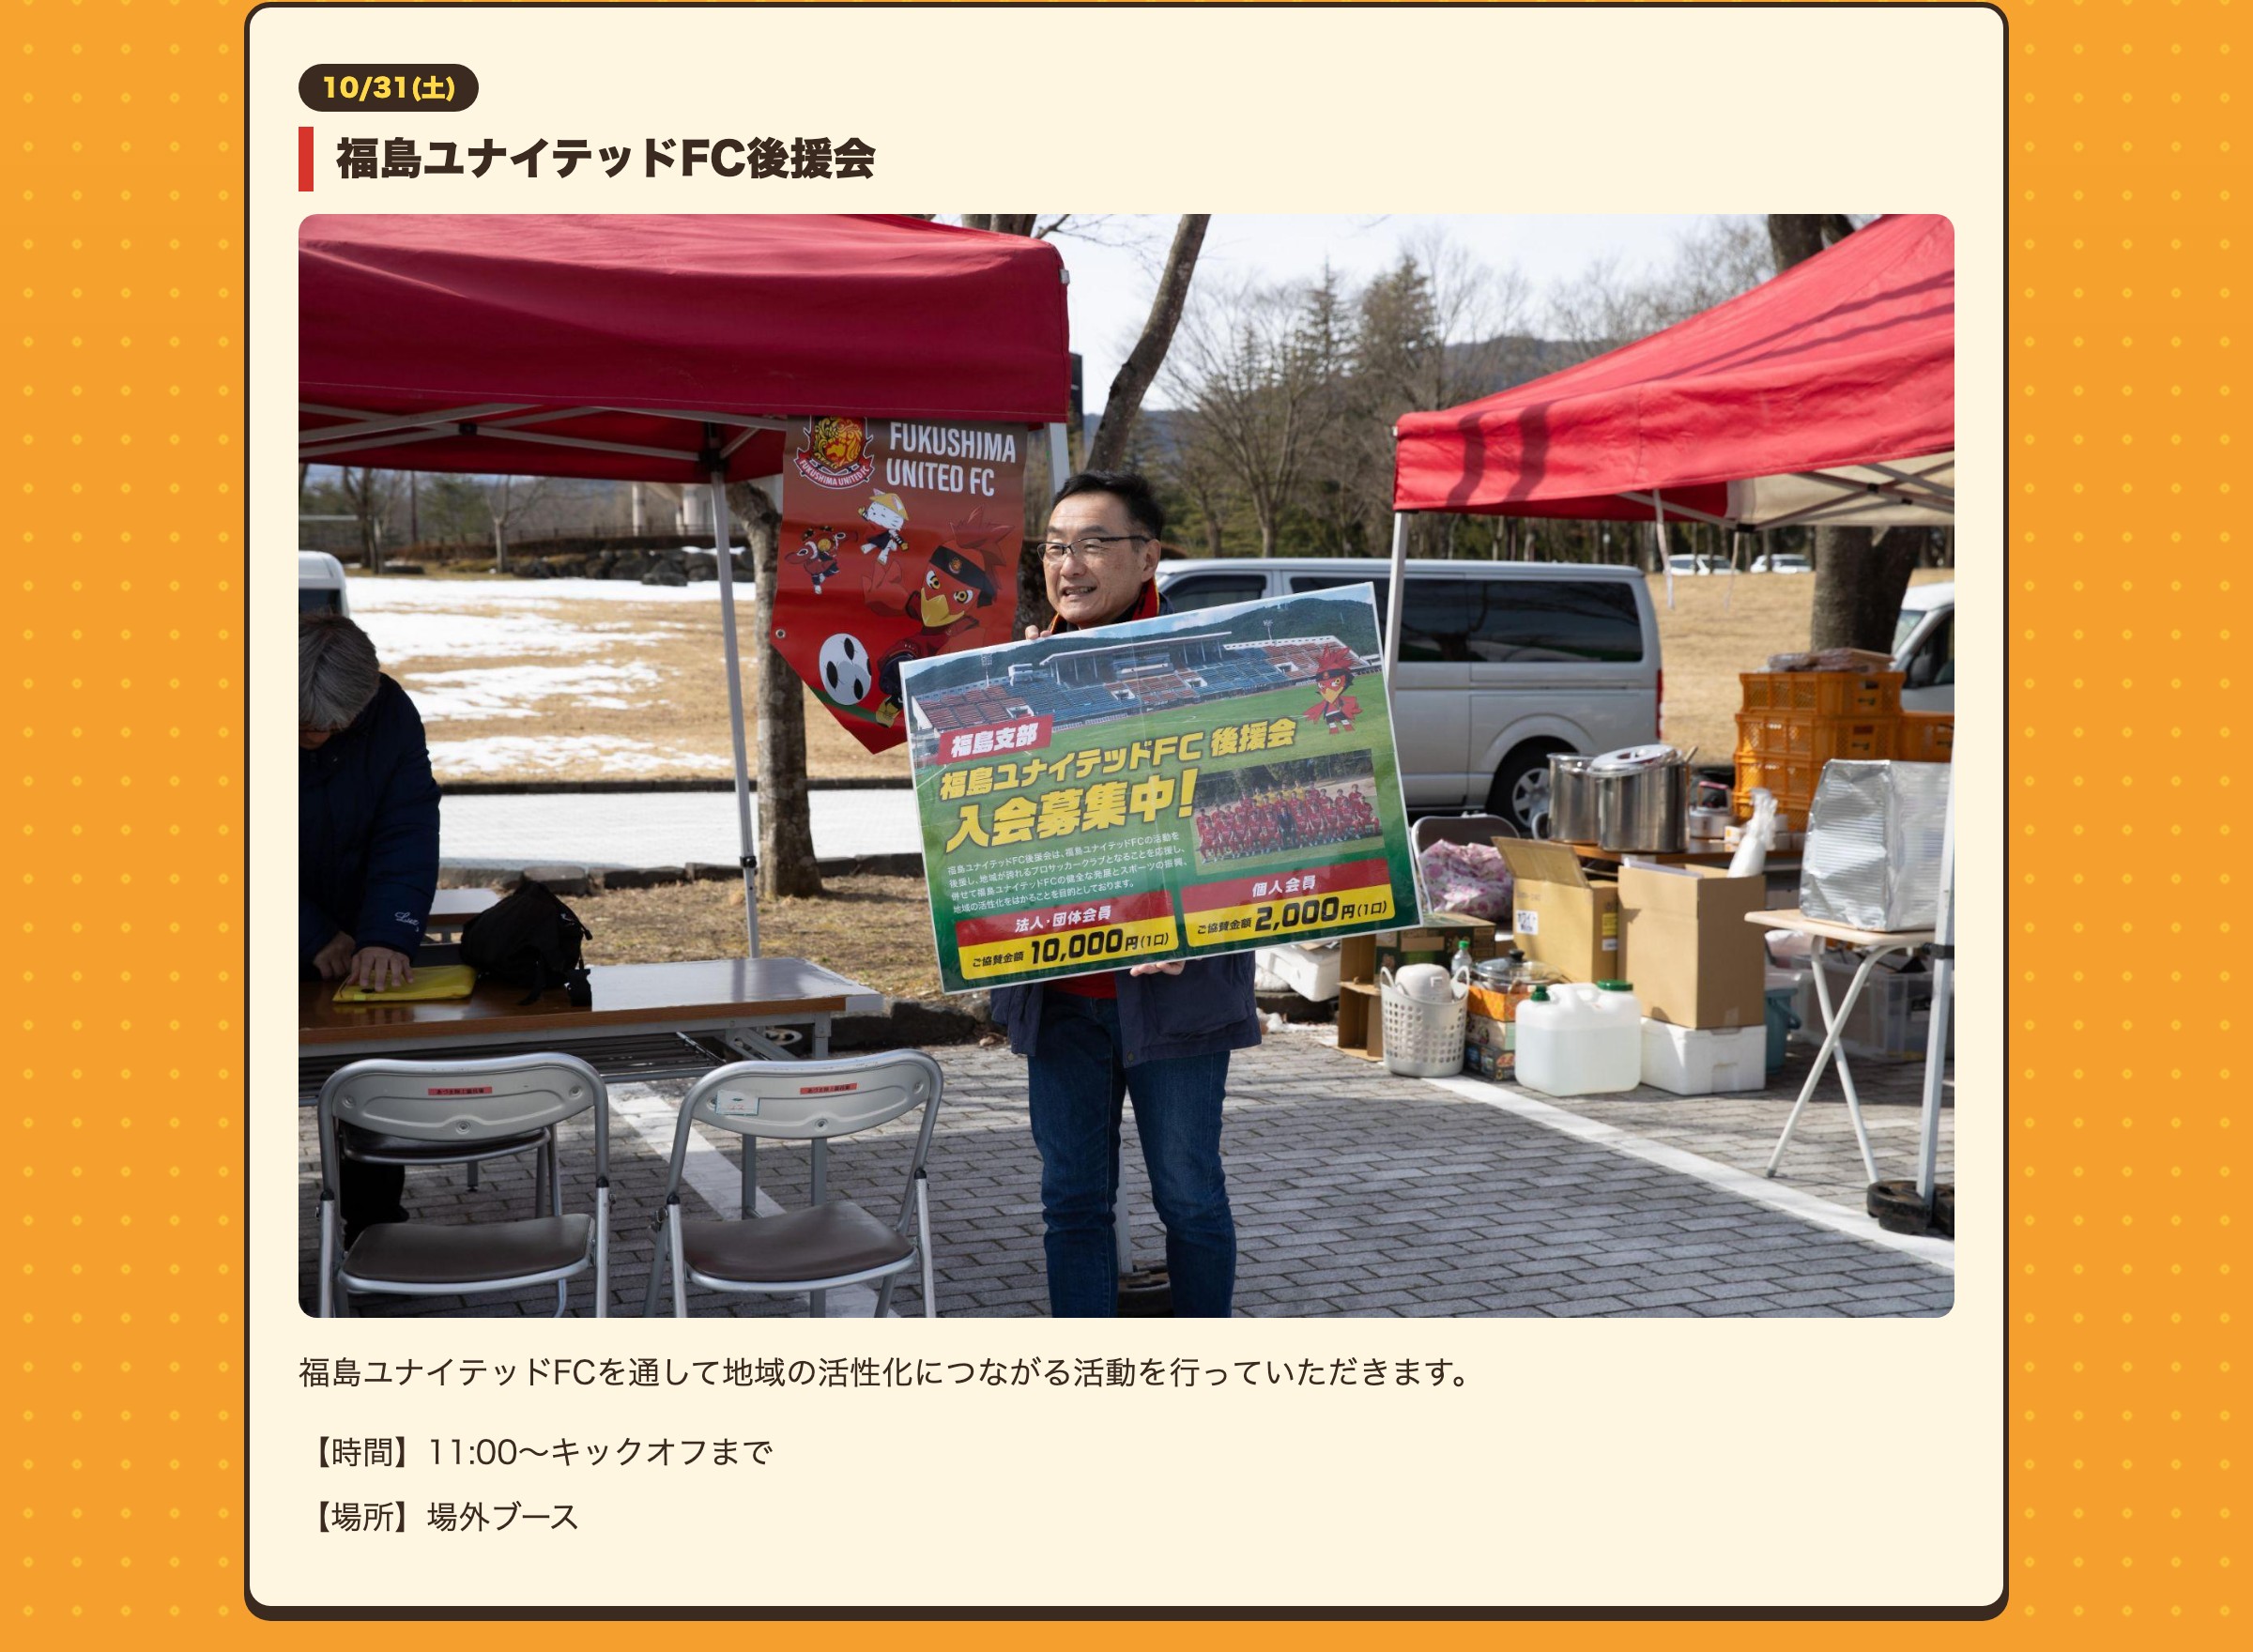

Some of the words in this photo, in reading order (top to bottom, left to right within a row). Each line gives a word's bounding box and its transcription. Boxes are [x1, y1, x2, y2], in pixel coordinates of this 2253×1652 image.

[890, 421, 1017, 464] FUKUSHIMA
[799, 459, 837, 486] FUKUSHIMA
[838, 472, 863, 486] UNITED
[886, 458, 964, 495] UNITED
[970, 467, 995, 497] FC
[950, 722, 1039, 758] 福島支部
[940, 732, 1204, 801] 福島ユナイテッドFC
[1210, 717, 1297, 757] 後援会
[1251, 875, 1316, 898] 個人会員
[1197, 917, 1252, 935] ご協賛金額
[972, 951, 1024, 968] ご協賛金額
